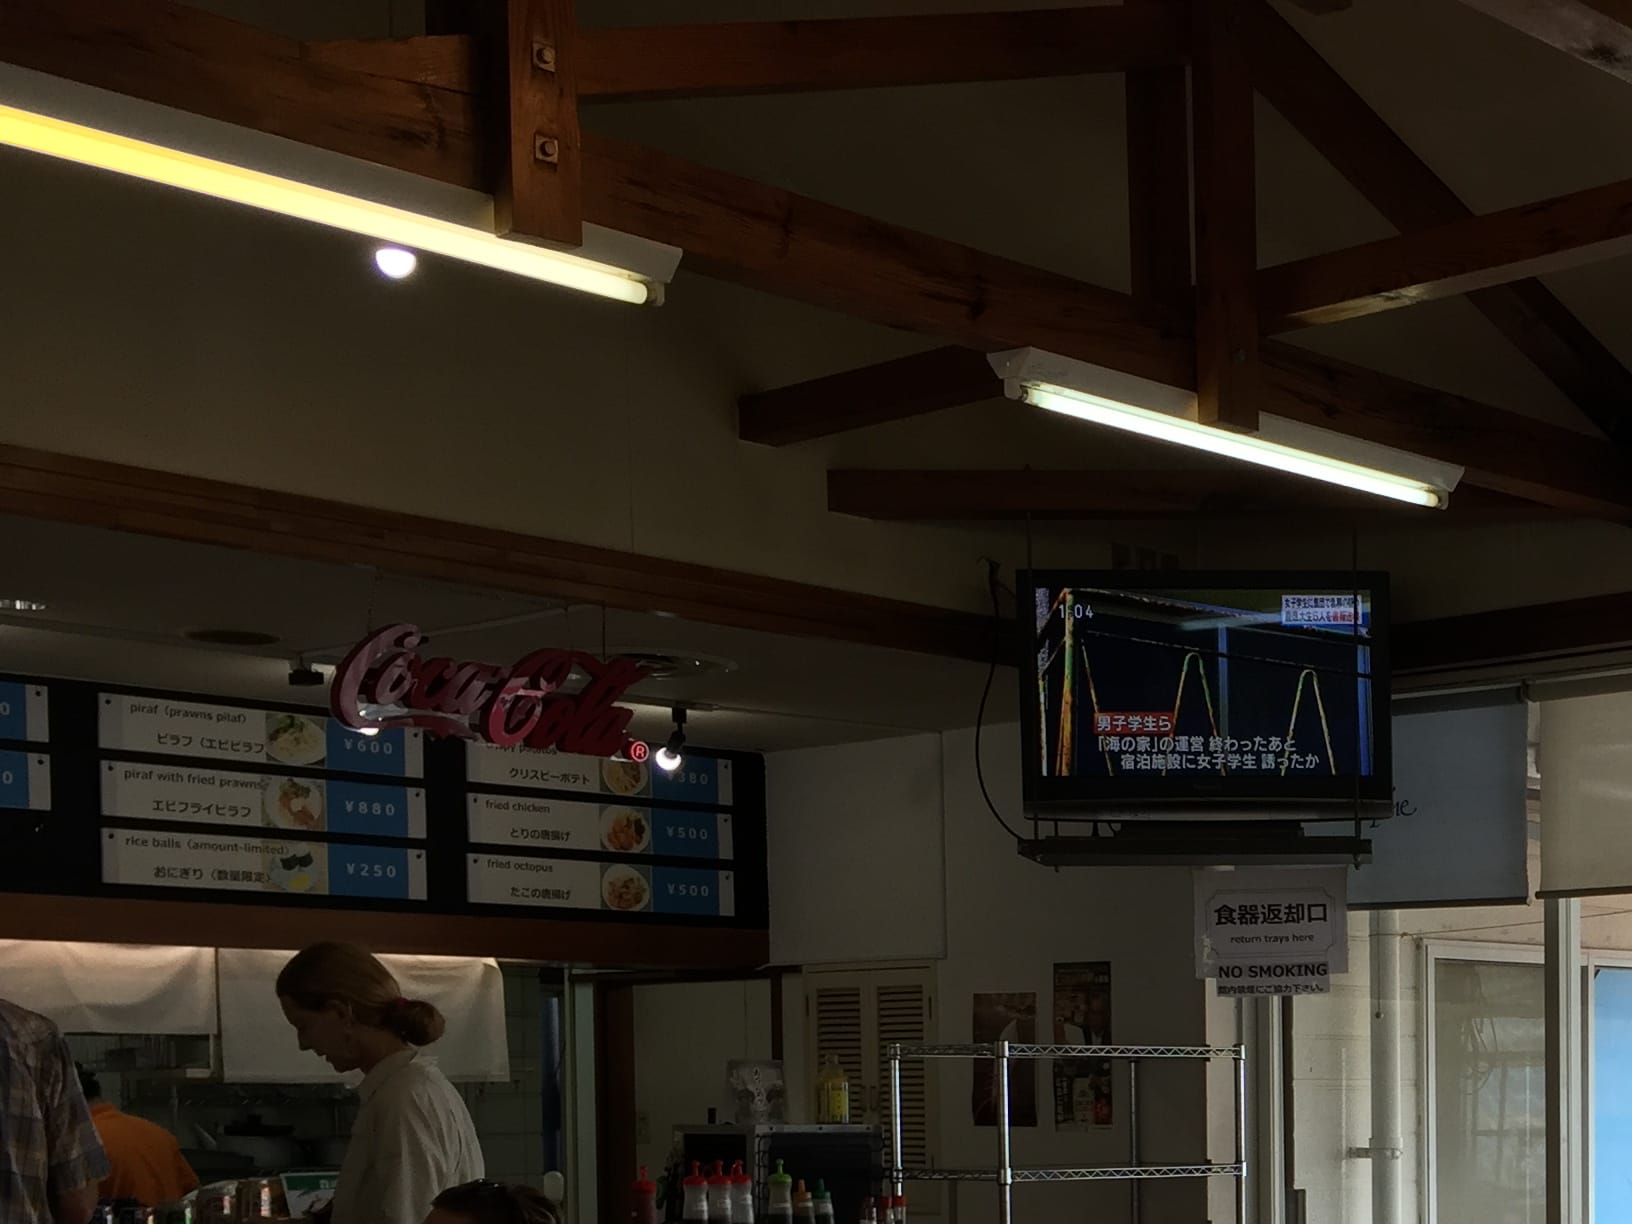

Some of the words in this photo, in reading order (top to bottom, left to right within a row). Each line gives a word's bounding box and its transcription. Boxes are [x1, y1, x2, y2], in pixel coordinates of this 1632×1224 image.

[130, 703, 158, 715] piraf
[1096, 715, 1173, 732] 男子学生ら
[344, 738, 394, 756] ¥600
[1208, 735, 1297, 753] 終わったあと
[1120, 753, 1257, 770] 宿泊施設に女子学生
[1261, 753, 1320, 770] 誘ったか
[124, 769, 153, 782] piraf
[157, 771, 184, 784] with
[187, 773, 216, 786] fried
[509, 767, 590, 785] クリスピーポテト
[345, 800, 396, 817] ¥880
[486, 800, 509, 811] fried
[512, 802, 550, 813] chicken
[510, 828, 570, 842] とりの唐揚げ
[666, 826, 708, 840] ¥500
[125, 836, 149, 847] rice
[152, 838, 181, 850] balls
[346, 863, 397, 879] ¥250
[487, 859, 511, 870] fried
[514, 862, 553, 874] octopus
[667, 884, 709, 897] ¥500
[1214, 903, 1328, 926] 食器返却口
[1230, 936, 1262, 944] return
[1264, 934, 1290, 945] trays
[1292, 933, 1314, 942] here
[1218, 965, 1243, 979] NO
[1248, 963, 1328, 978] SMOKING
